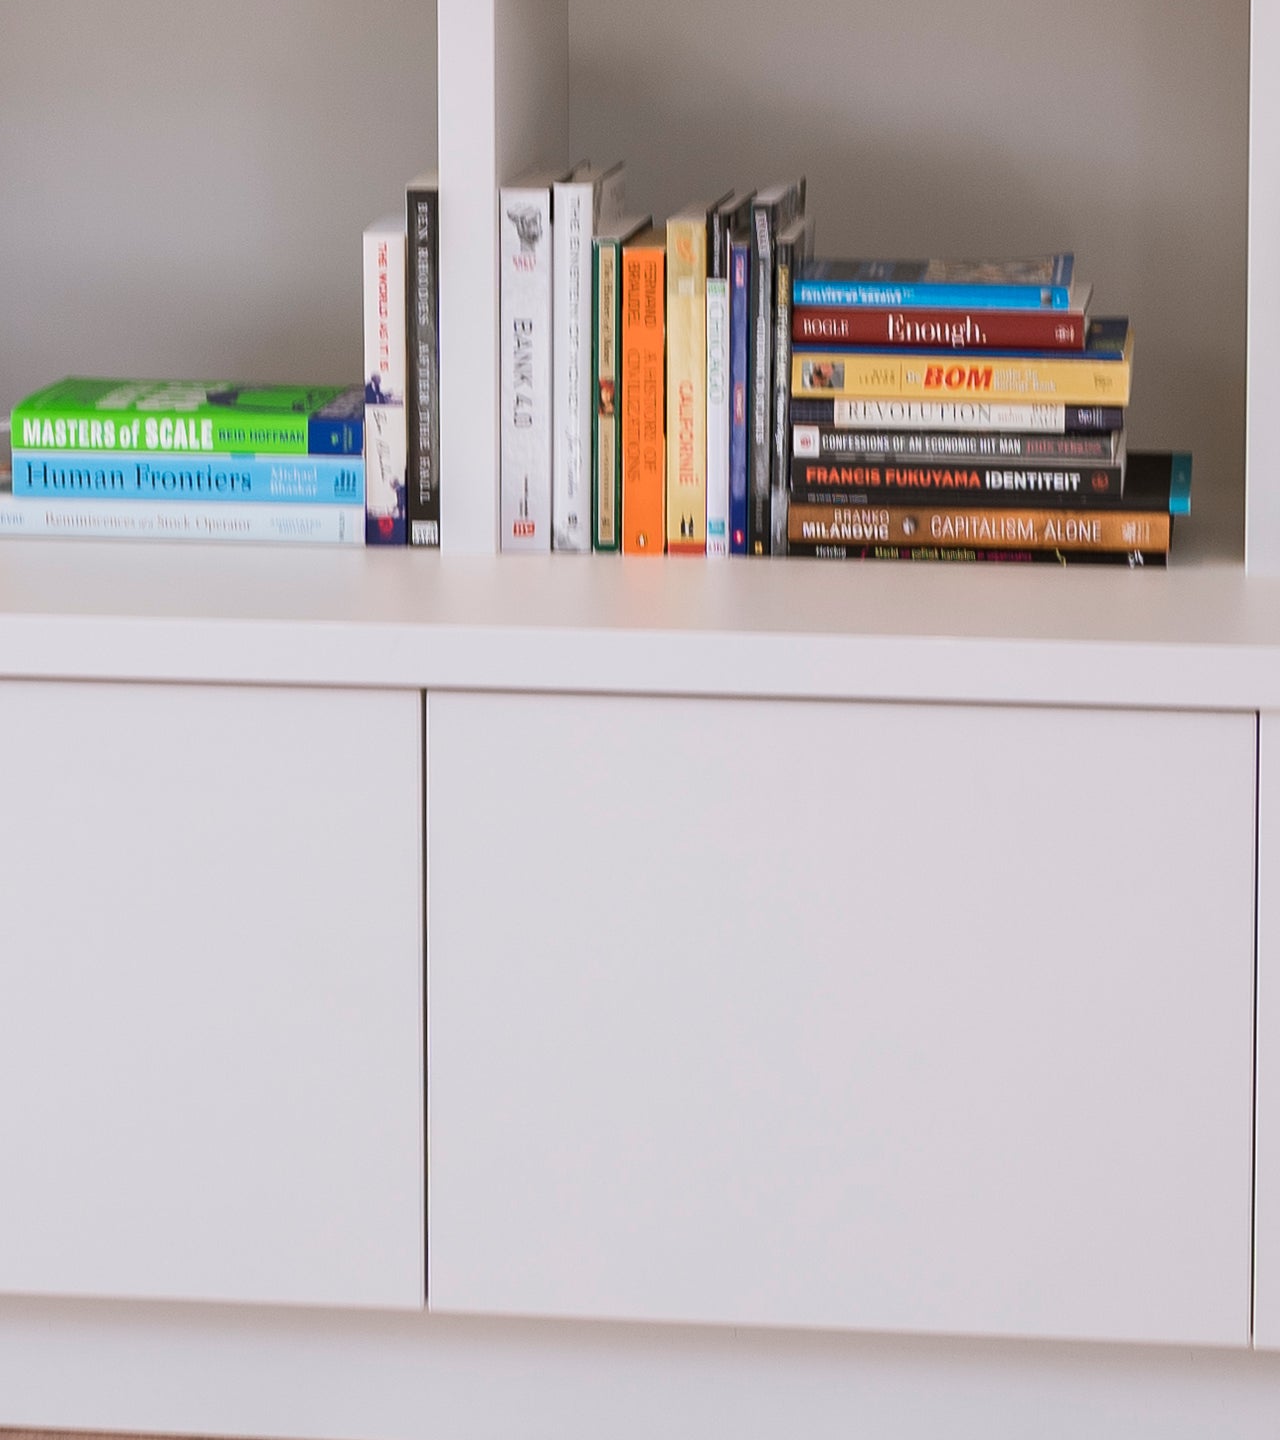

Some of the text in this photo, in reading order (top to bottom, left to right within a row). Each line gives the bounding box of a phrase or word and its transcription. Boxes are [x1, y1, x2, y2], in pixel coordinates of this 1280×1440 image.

[803, 313, 986, 348] BOGLE Enough.
[923, 363, 995, 391] BOM
[848, 401, 991, 421] REVOLUTION
[23, 418, 305, 450] MASTERS of SCALE REID HOFFMAN
[822, 434, 1021, 454] CONFESSIONS OF AN ECONOMIC HIT MAN
[26, 461, 252, 492] Human Frontiers
[271, 466, 317, 481] Michael
[806, 466, 1081, 491] FRANCIS FUKUYAMA IDENTITEIT
[271, 482, 317, 497] Bhaskar
[834, 509, 889, 523] BRANKO
[931, 515, 1101, 543] CAPITALISM, ALONE
